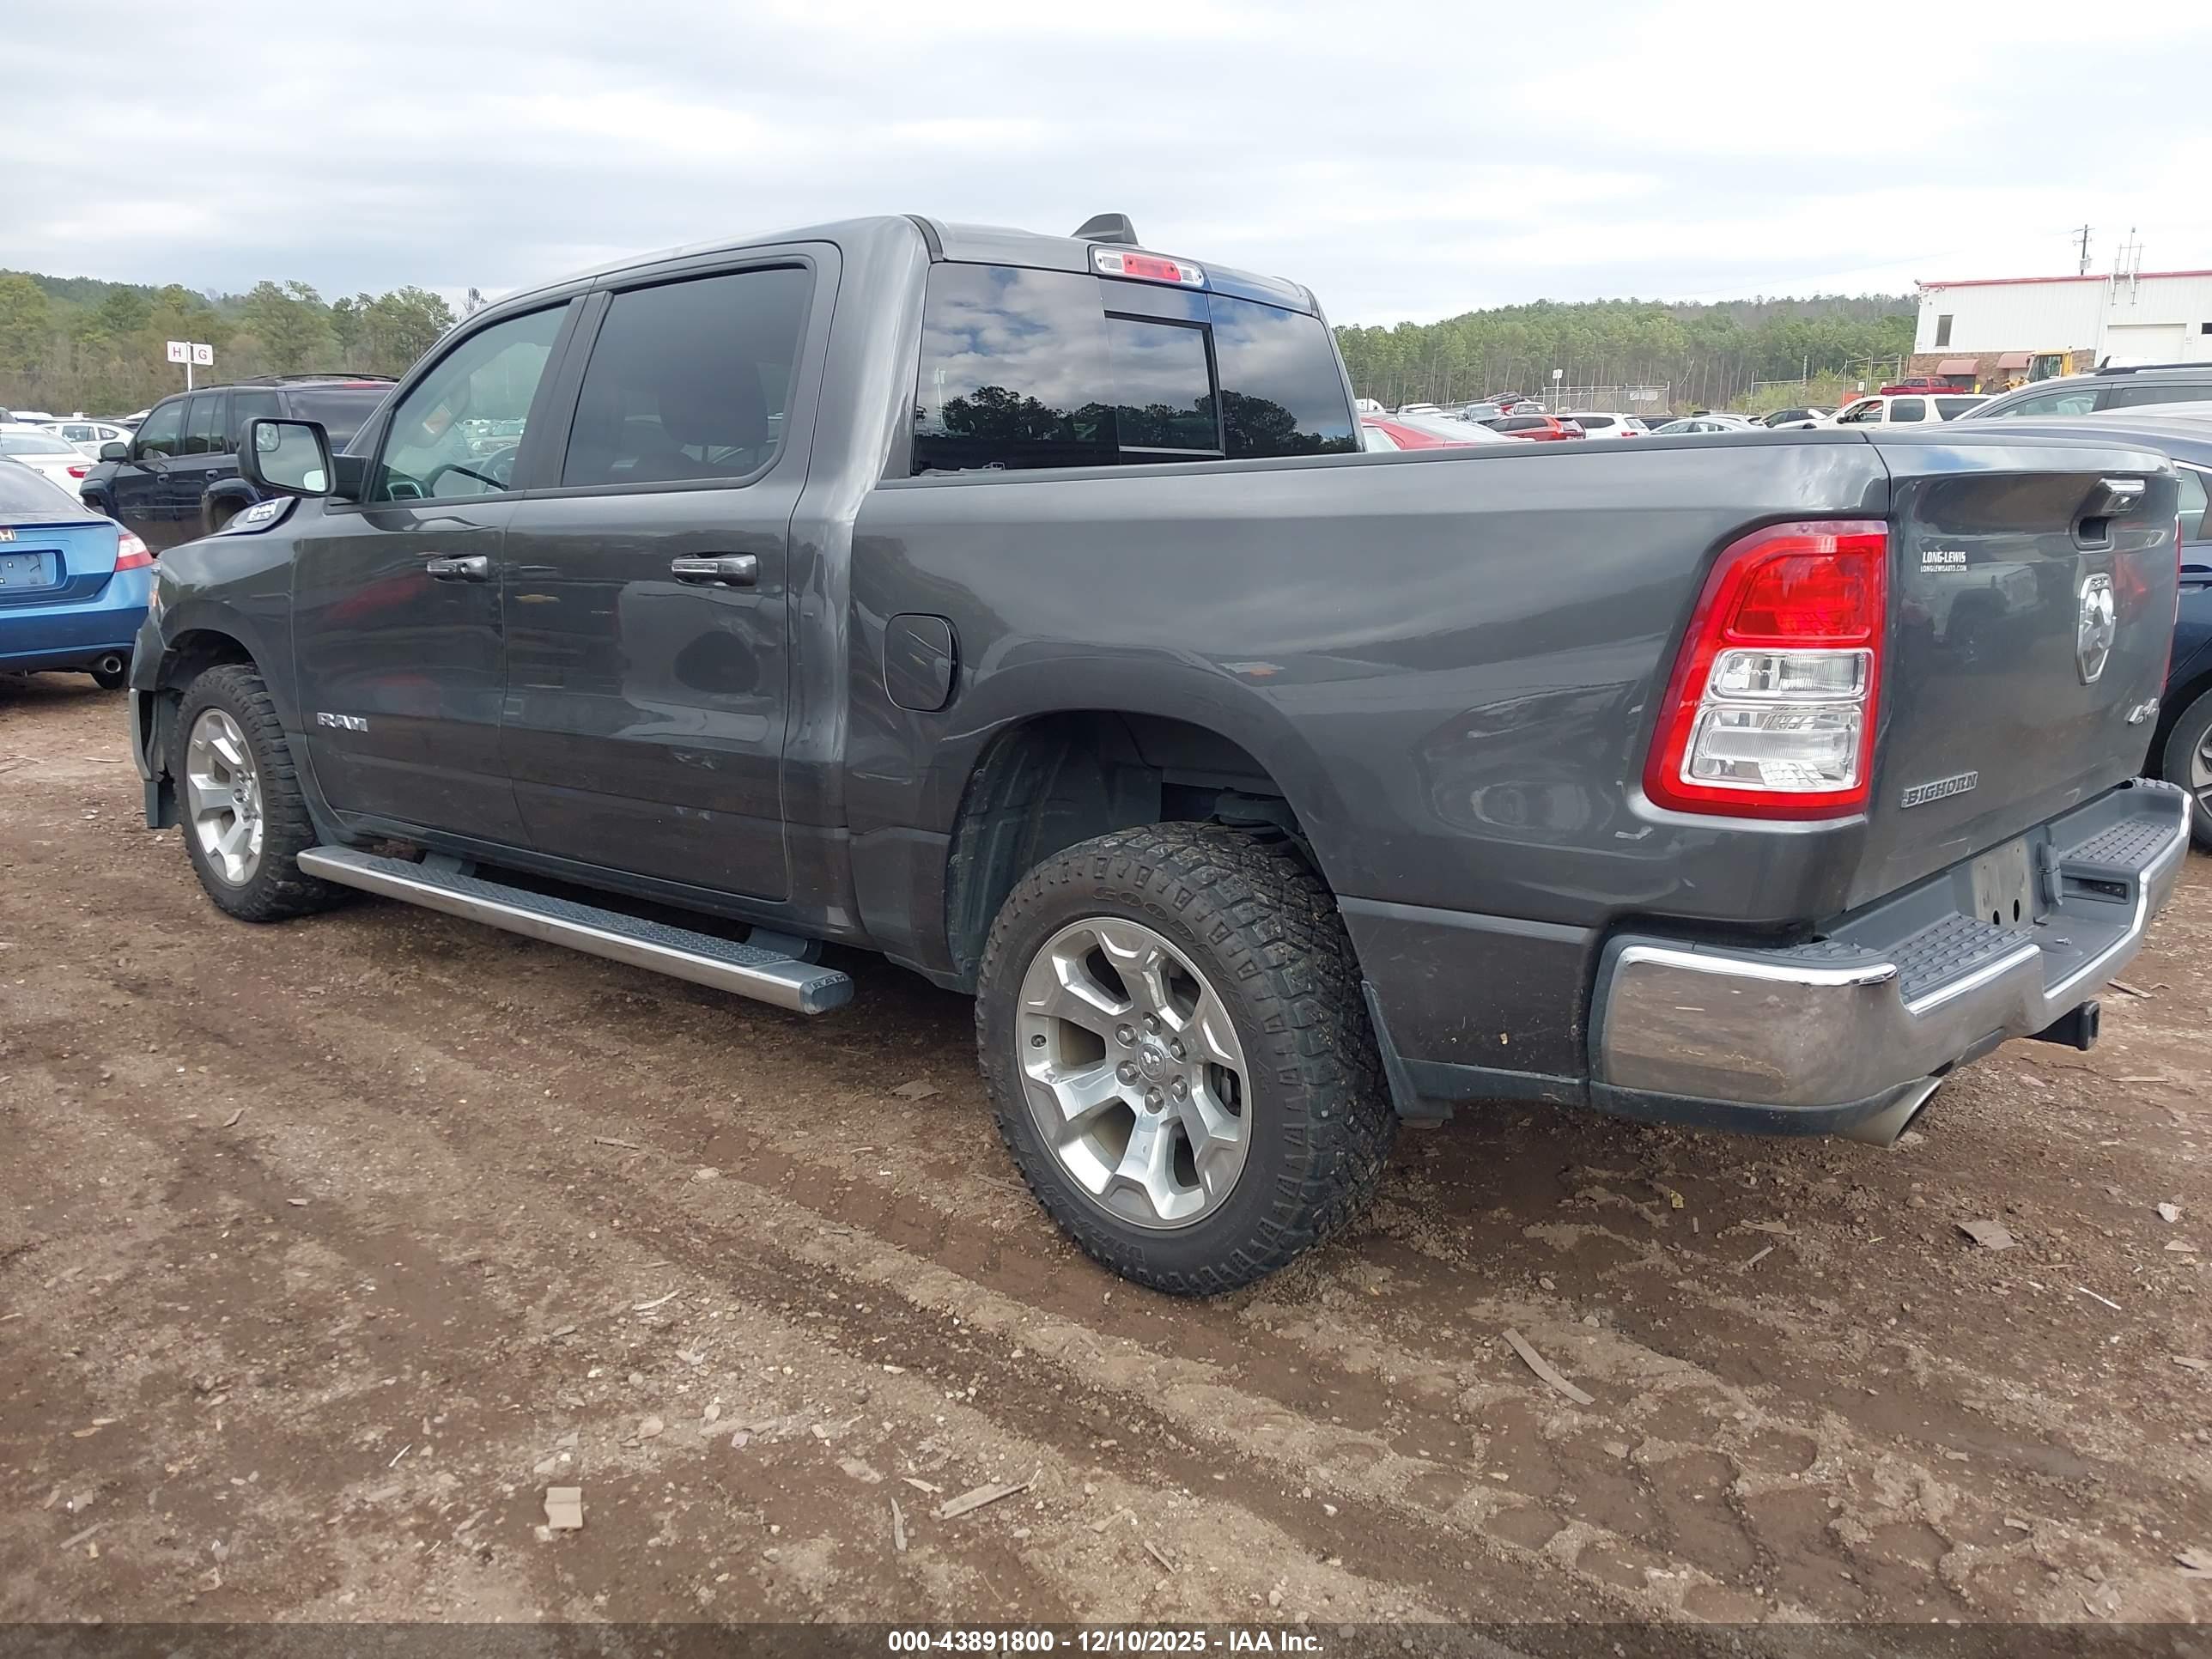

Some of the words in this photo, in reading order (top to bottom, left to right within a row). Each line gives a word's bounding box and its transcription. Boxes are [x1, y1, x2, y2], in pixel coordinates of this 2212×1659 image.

[173, 346, 181, 357] H
[198, 349, 208, 360] G
[1922, 550, 1966, 563] LONG-LEWIS
[317, 712, 368, 732] RAM
[1903, 772, 1978, 807] BIGHORN
[1091, 885, 1273, 1096] GOODYEAR
